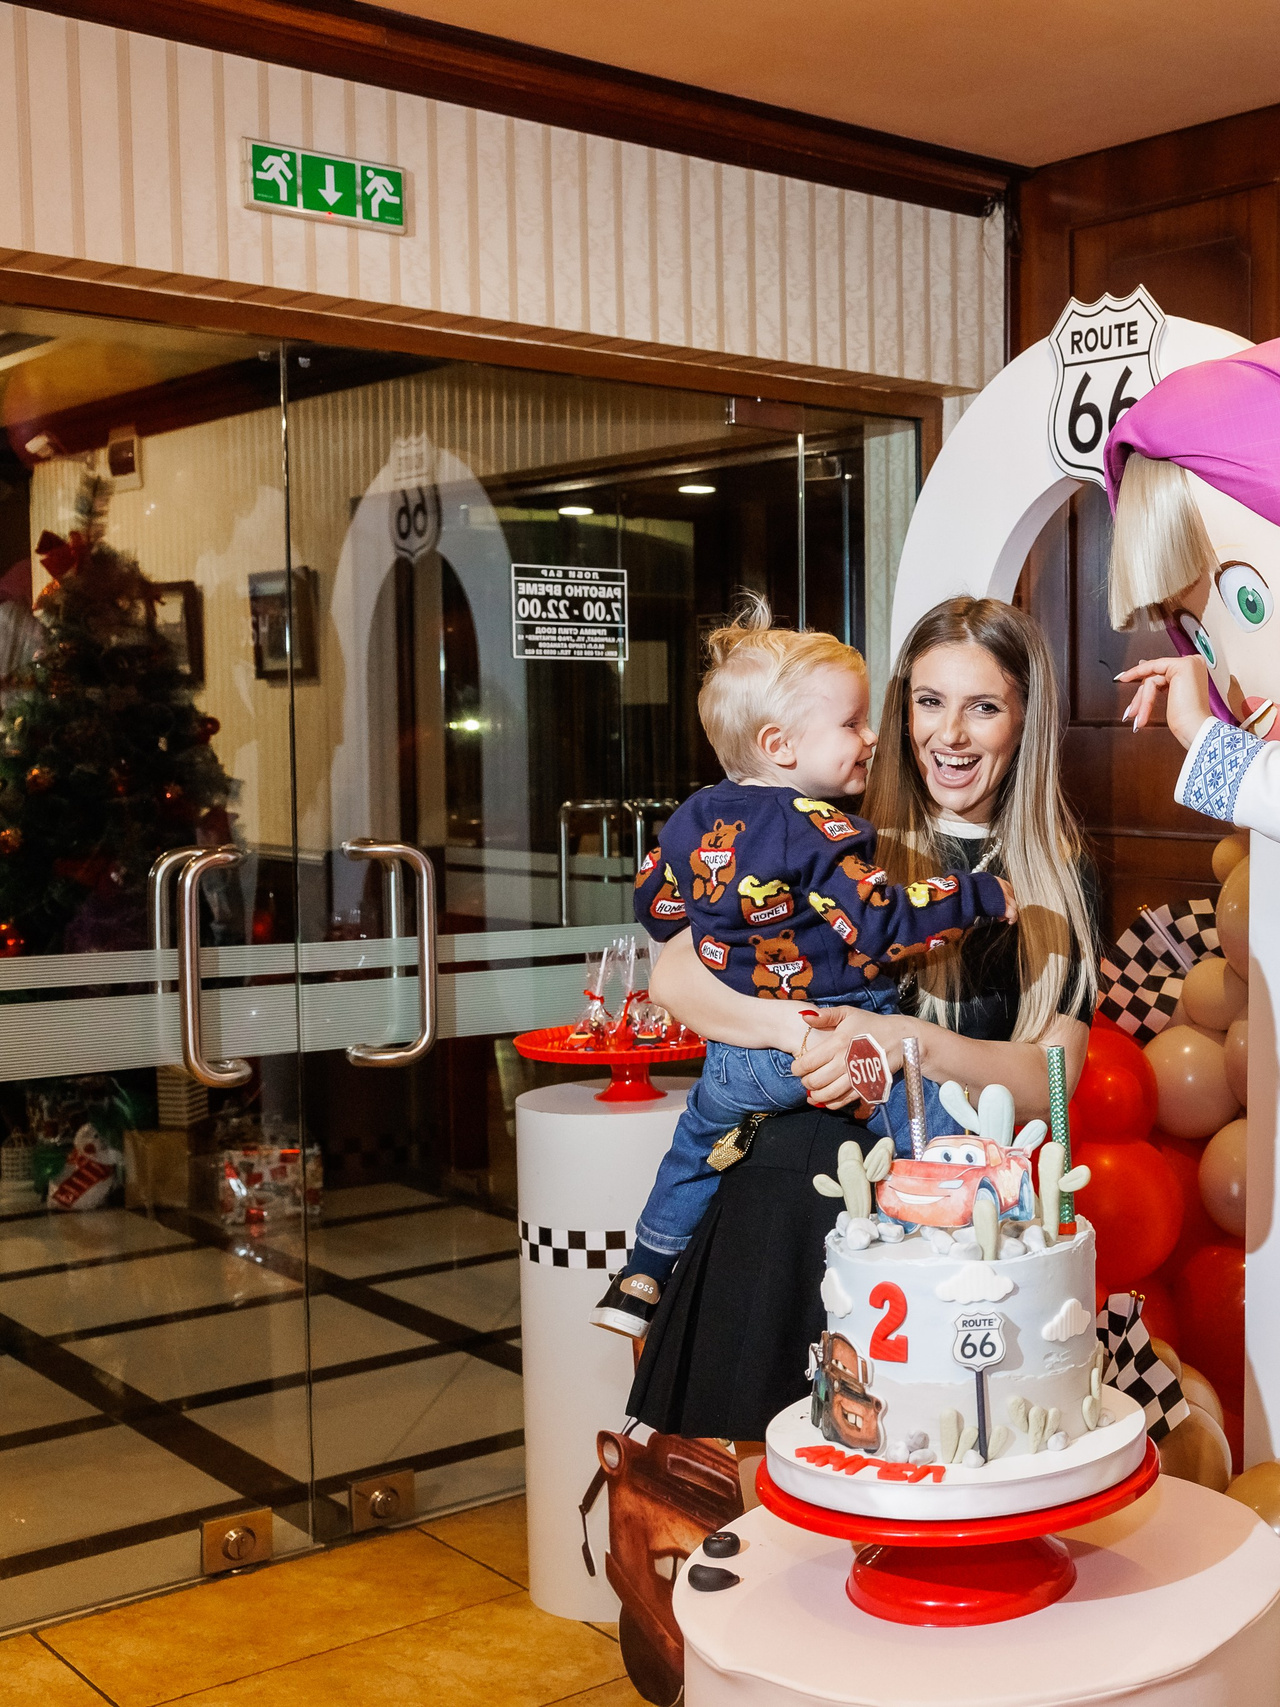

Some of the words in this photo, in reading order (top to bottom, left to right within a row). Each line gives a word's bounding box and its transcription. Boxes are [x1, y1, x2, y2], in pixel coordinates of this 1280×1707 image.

[1071, 320, 1138, 354] ROUTE
[704, 854, 728, 865] GUESS
[657, 902, 685, 912] HONE
[753, 904, 786, 921] HONEY
[703, 945, 723, 960] HONEY
[772, 962, 801, 974] GUESS
[850, 1057, 881, 1084] STOP
[631, 1280, 654, 1294] BOSS
[869, 1281, 908, 1363] 2
[962, 1318, 994, 1328] ROUTE
[961, 1332, 996, 1359] 66
